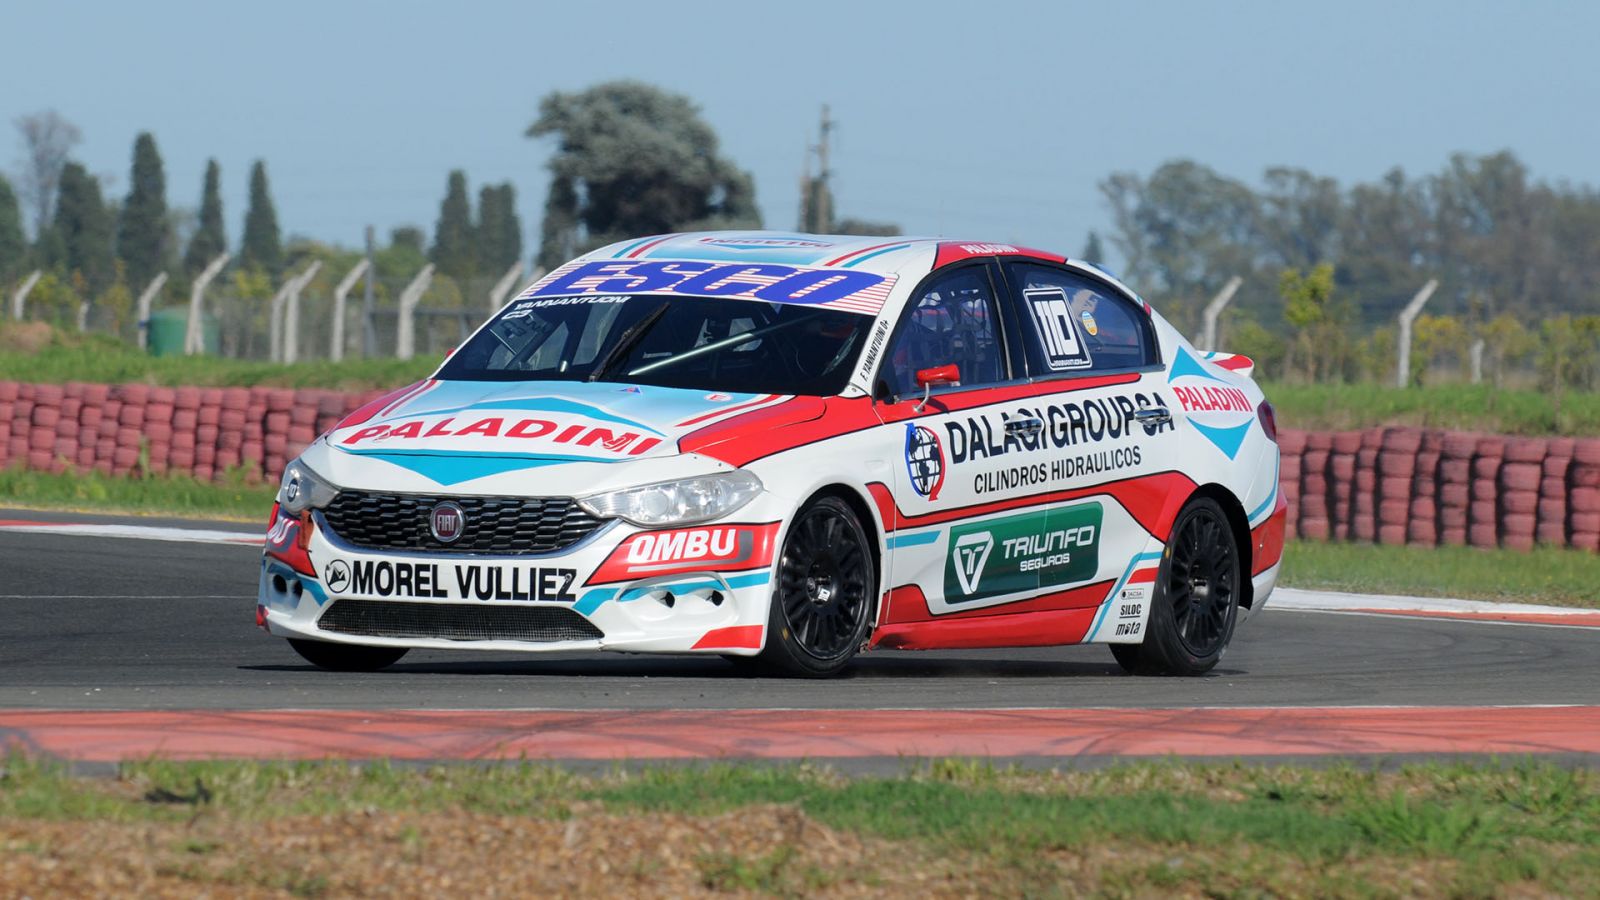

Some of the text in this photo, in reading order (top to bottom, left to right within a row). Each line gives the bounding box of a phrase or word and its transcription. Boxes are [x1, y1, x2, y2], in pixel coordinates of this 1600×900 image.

[530, 261, 886, 305] ESCO
[514, 296, 632, 311] YANNANTUONI
[1033, 300, 1080, 356] 110
[863, 326, 887, 375] YANNANTUONI
[1172, 386, 1254, 413] PALADINI
[342, 417, 662, 456] PALADINI
[974, 445, 1142, 494] CILINDROS HIDRAULICOS
[437, 514, 457, 532] FIAT
[1002, 524, 1096, 559] TRIUNFO
[627, 528, 737, 564] OMBU
[1019, 552, 1071, 572] SEGUROS
[352, 560, 578, 603] MOREL VULLIEZ
